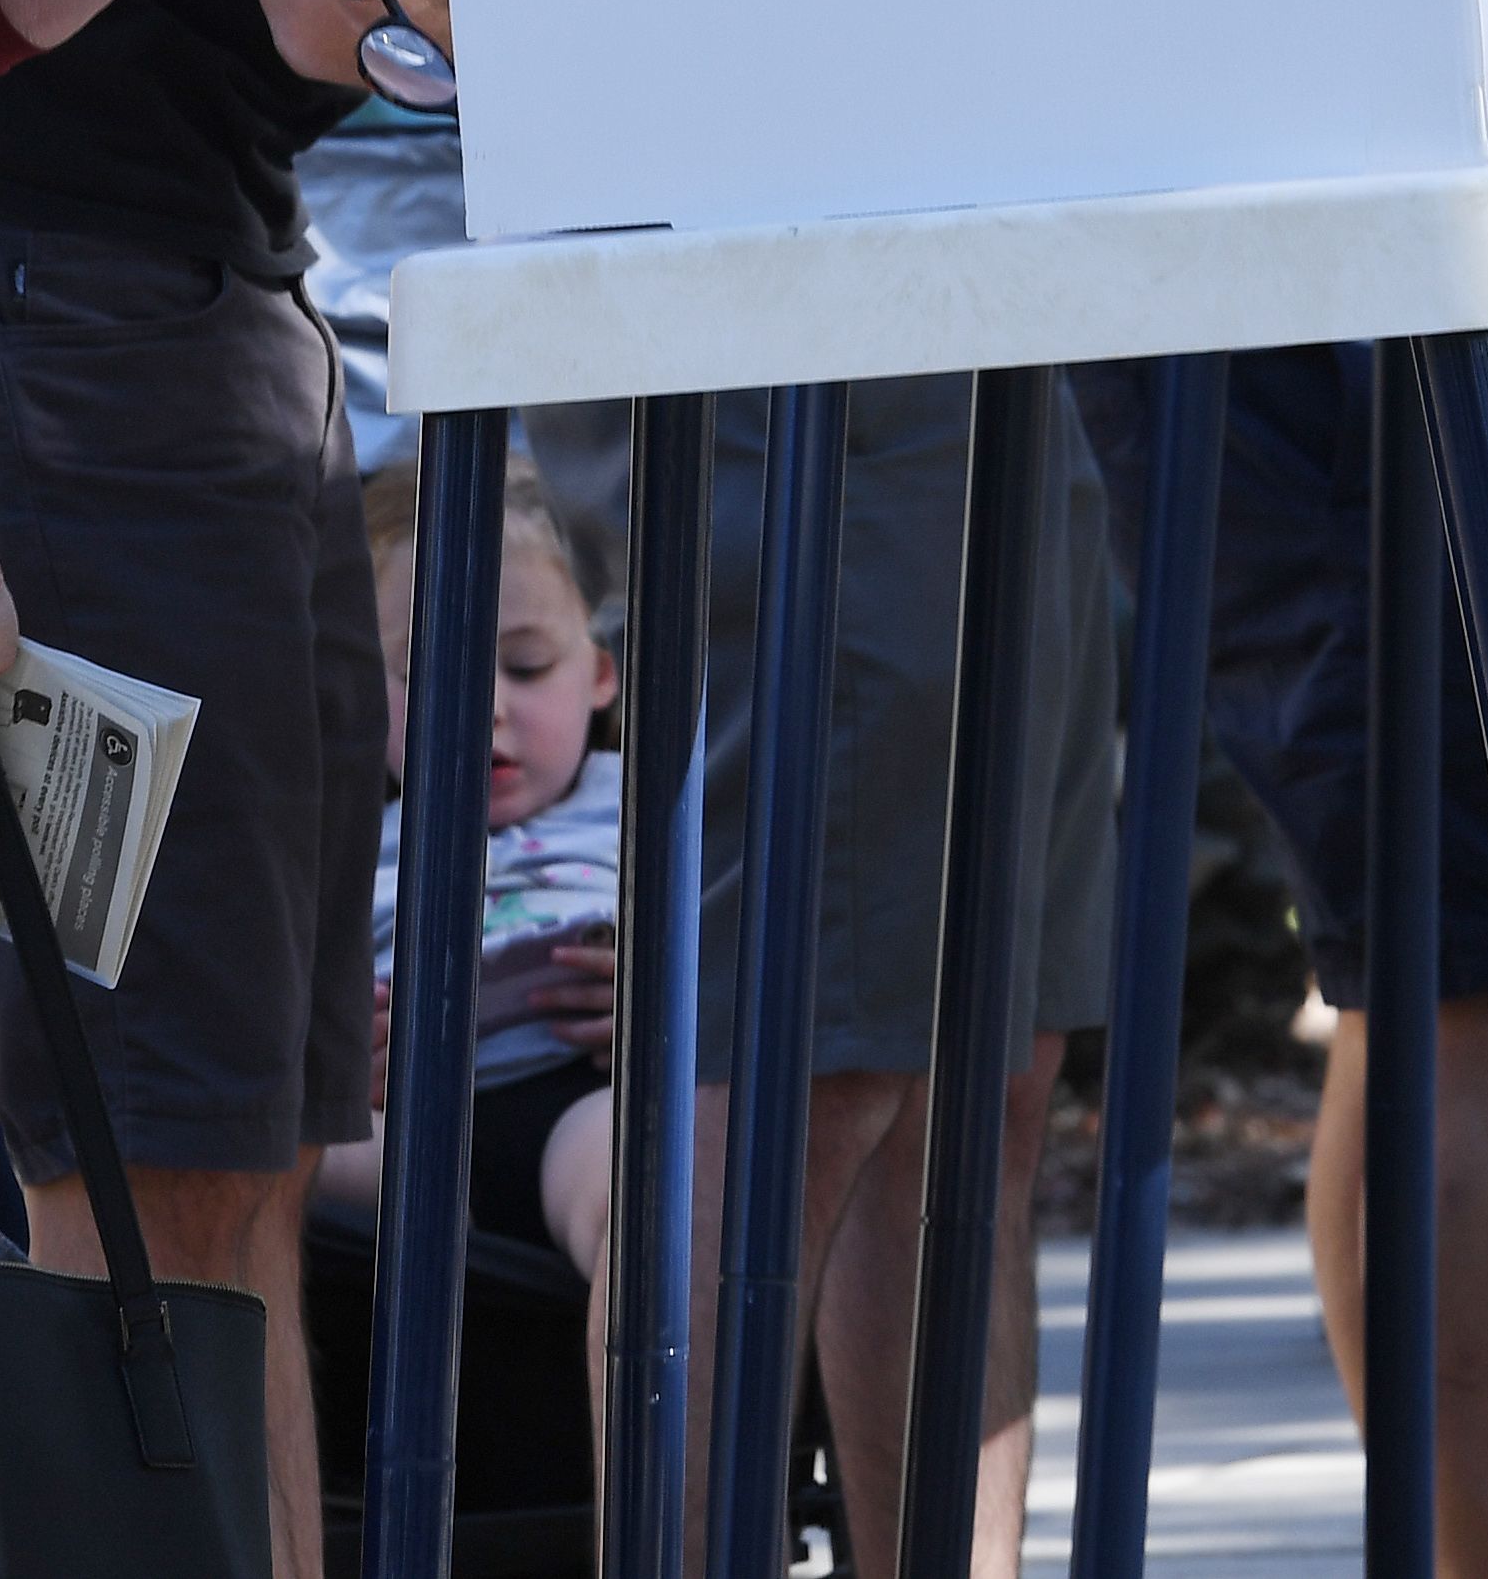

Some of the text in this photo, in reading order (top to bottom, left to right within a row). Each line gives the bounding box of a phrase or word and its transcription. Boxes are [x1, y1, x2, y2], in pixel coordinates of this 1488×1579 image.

[74, 765, 118, 931] Accessible polling places
